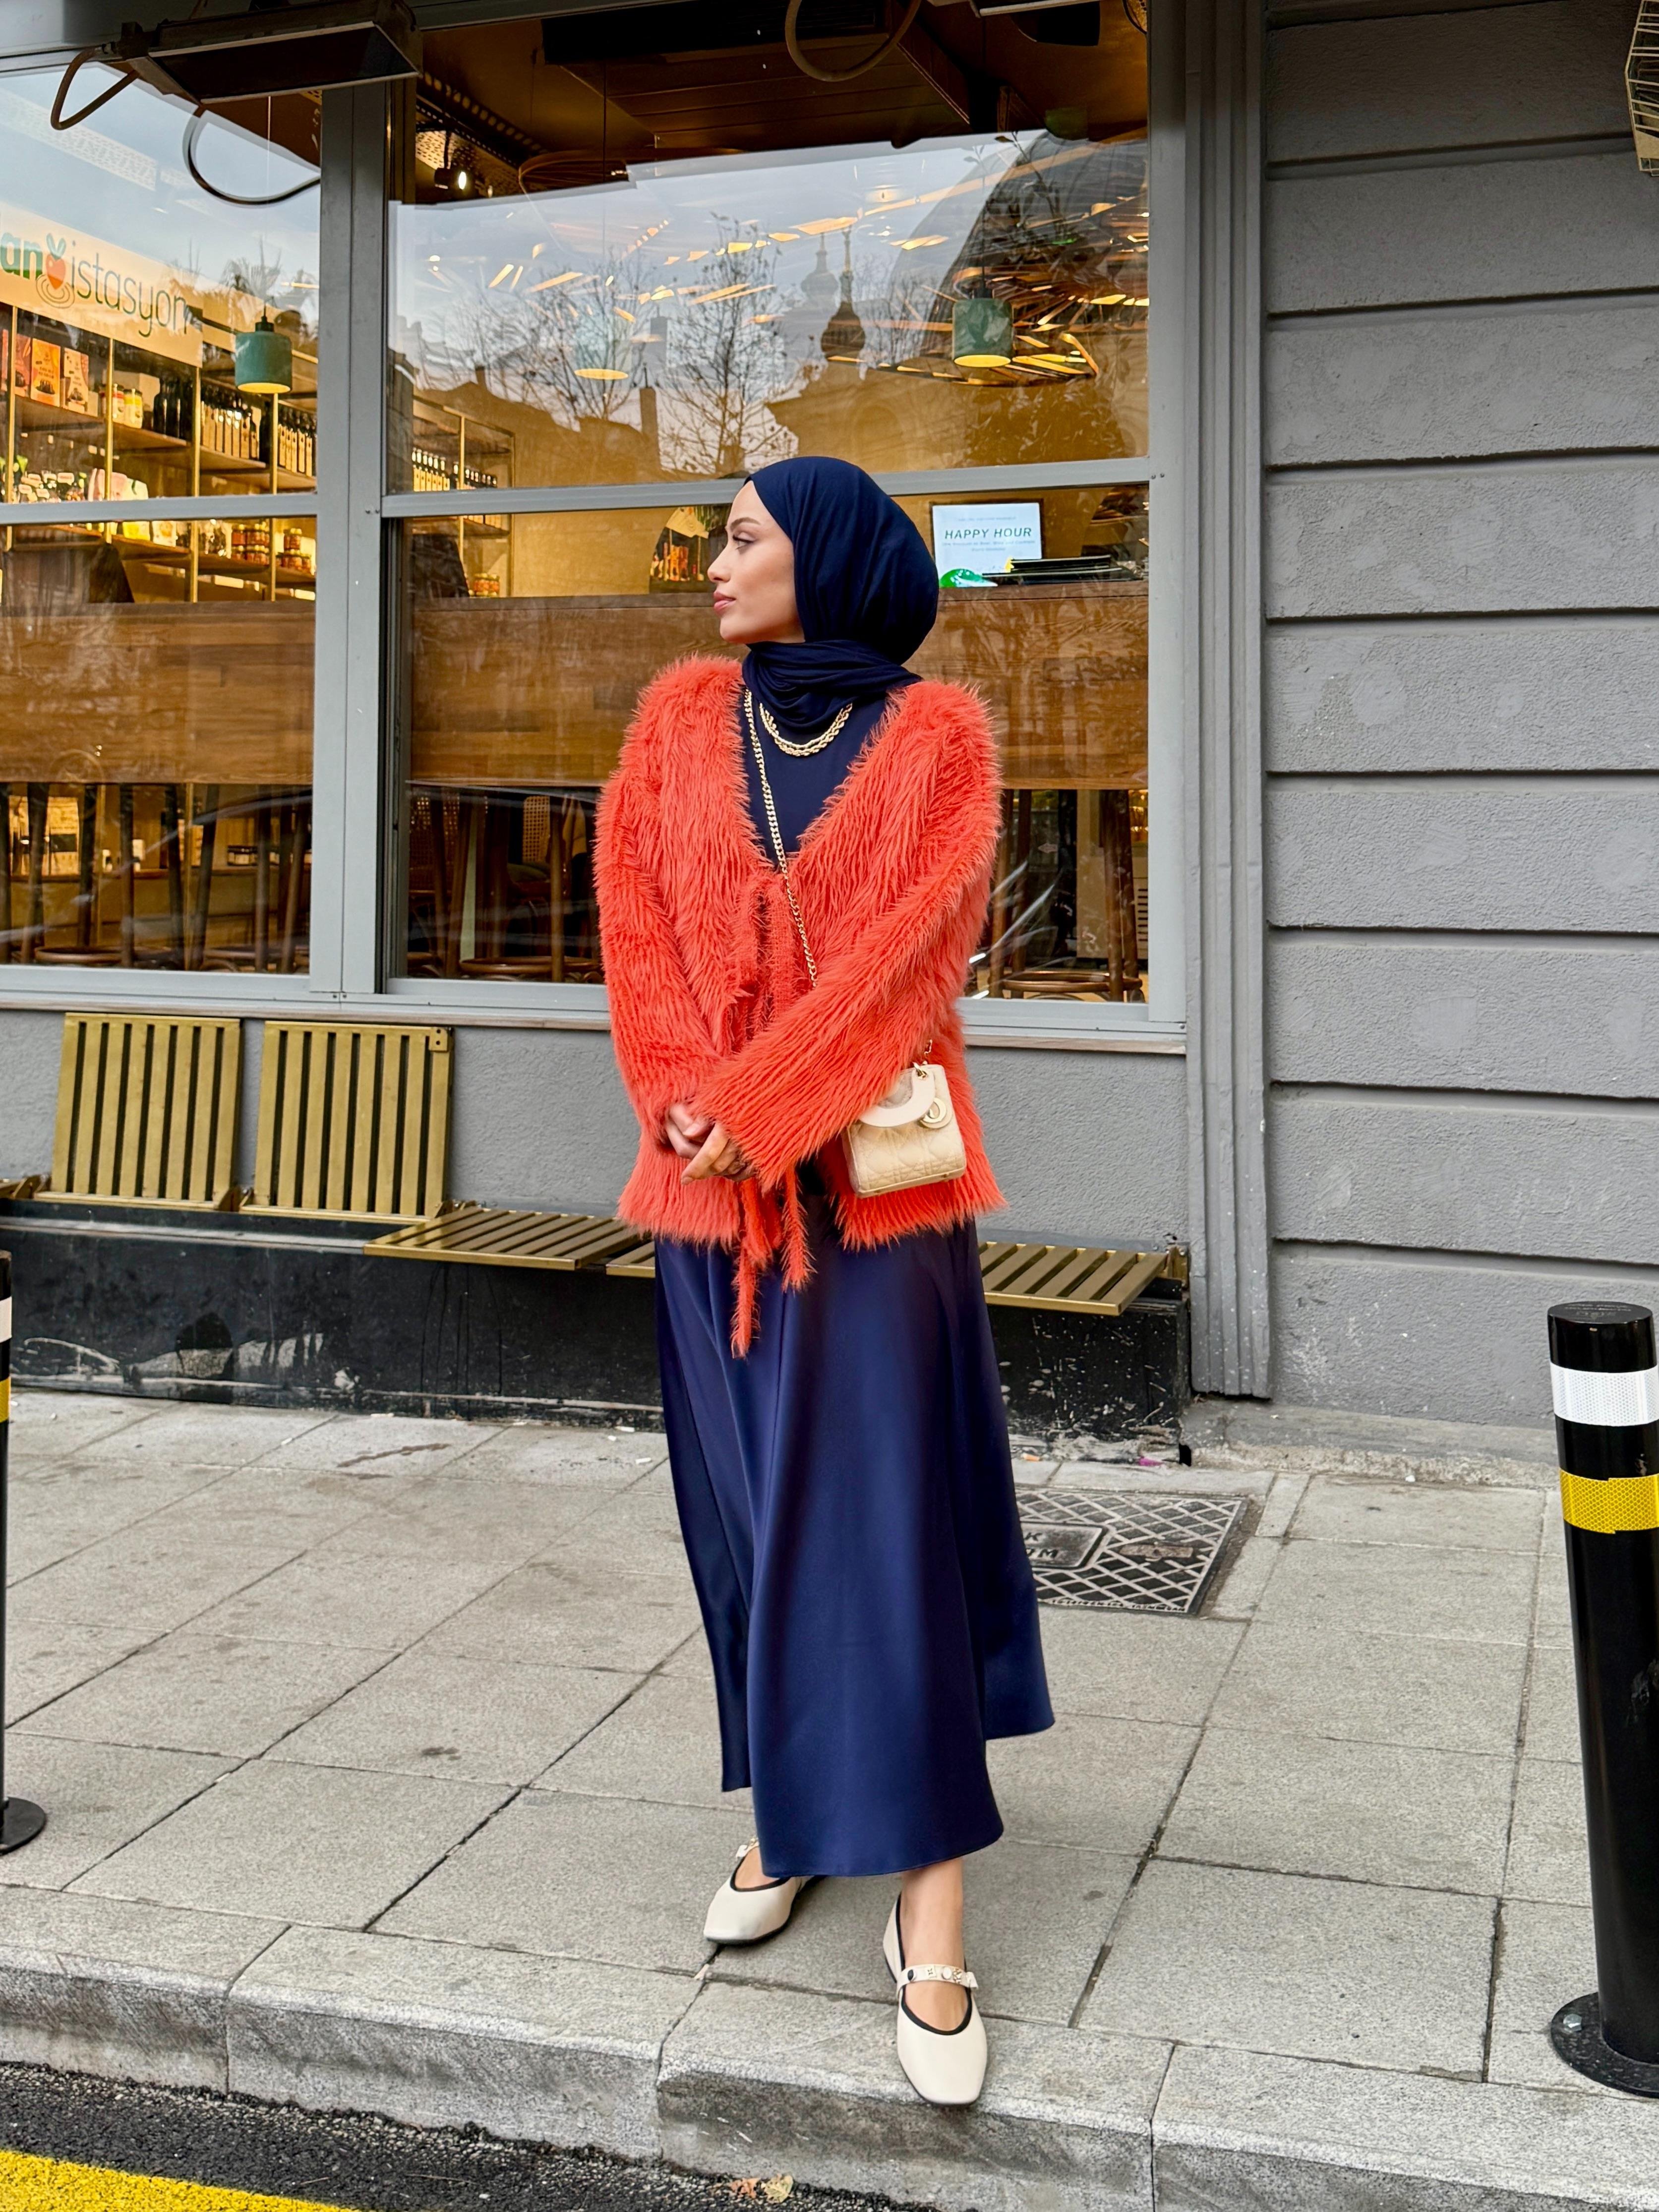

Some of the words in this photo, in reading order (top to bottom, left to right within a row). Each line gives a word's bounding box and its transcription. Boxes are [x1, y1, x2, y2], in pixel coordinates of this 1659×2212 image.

[71, 240, 187, 338] istasyon
[945, 529, 989, 539] HAPPY
[994, 527, 1032, 538] HOUR
